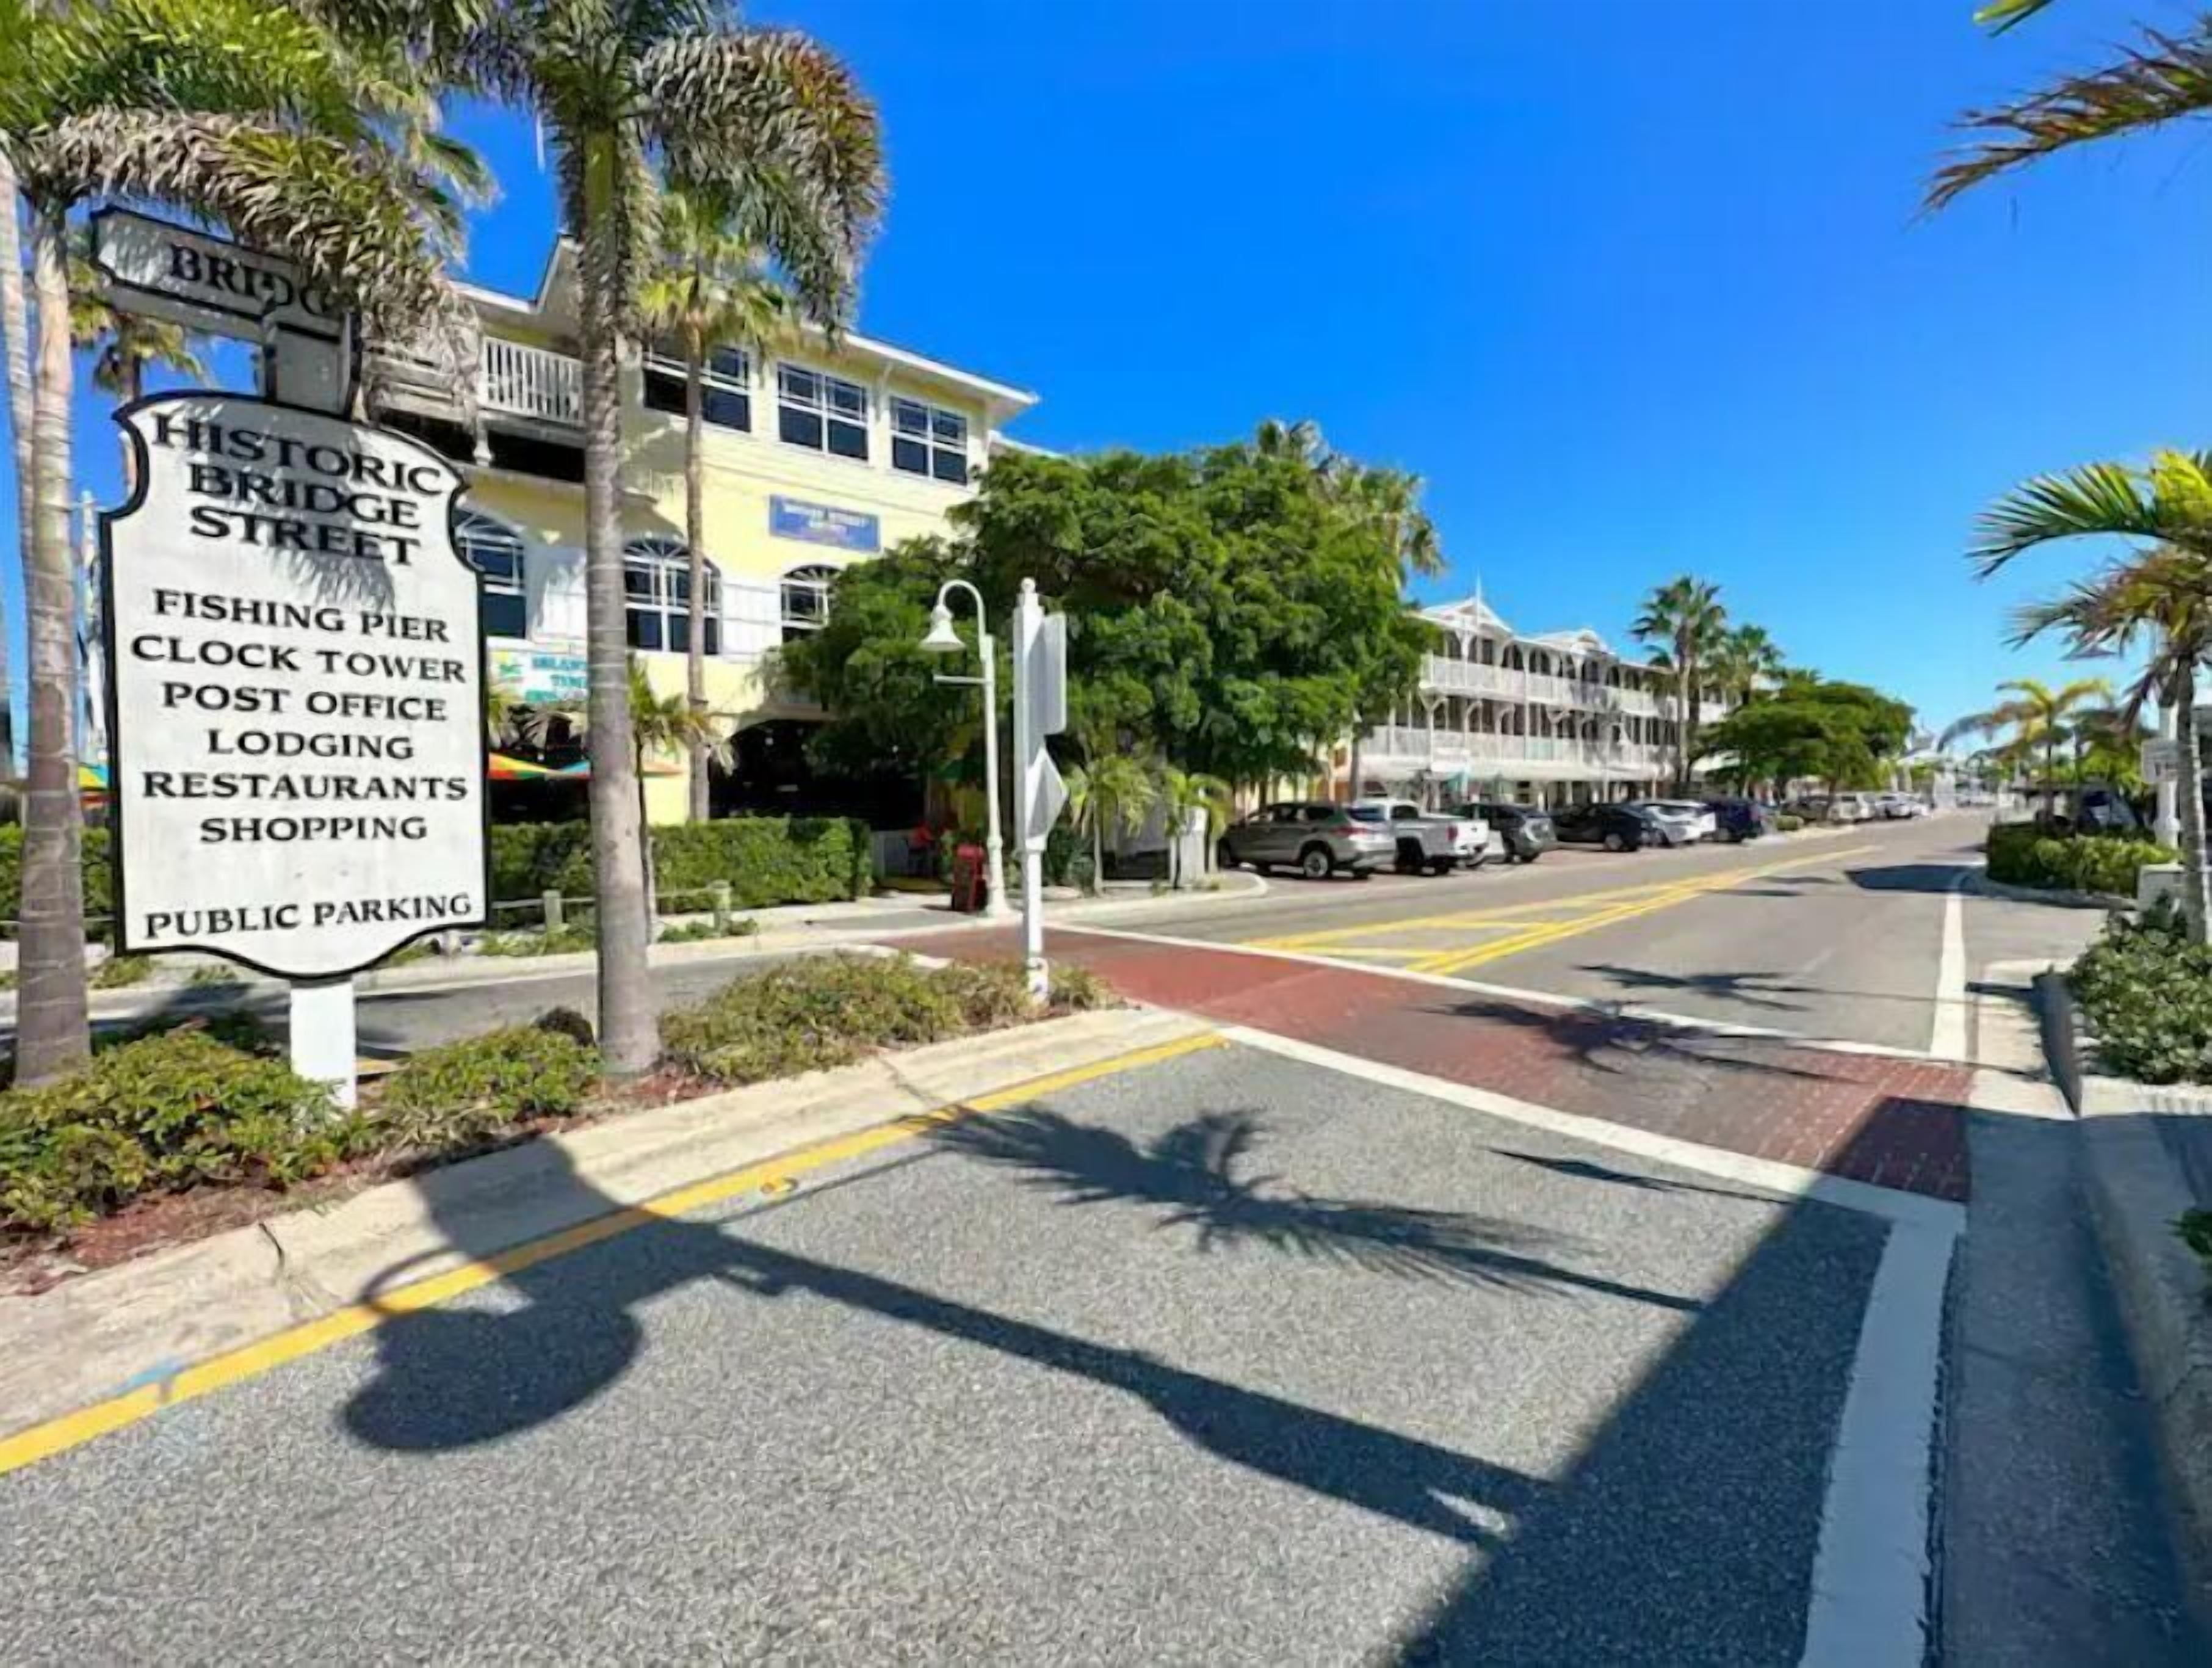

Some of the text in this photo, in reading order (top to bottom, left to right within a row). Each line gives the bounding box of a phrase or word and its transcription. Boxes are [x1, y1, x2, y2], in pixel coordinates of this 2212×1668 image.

[170, 245, 333, 318] BRIDG
[151, 413, 441, 496] HISTORIC
[188, 462, 421, 529] BRIDGE
[190, 506, 421, 565] STREET
[153, 588, 450, 643] FISHING PIER
[131, 634, 466, 684] CLOCK TOWER
[162, 681, 447, 722] POST OFFICE
[208, 729, 414, 760] LODGING
[142, 771, 468, 802] RESTAURANTS
[200, 816, 427, 843] SHOPPING
[145, 892, 472, 939] PUBLIC PARKING
